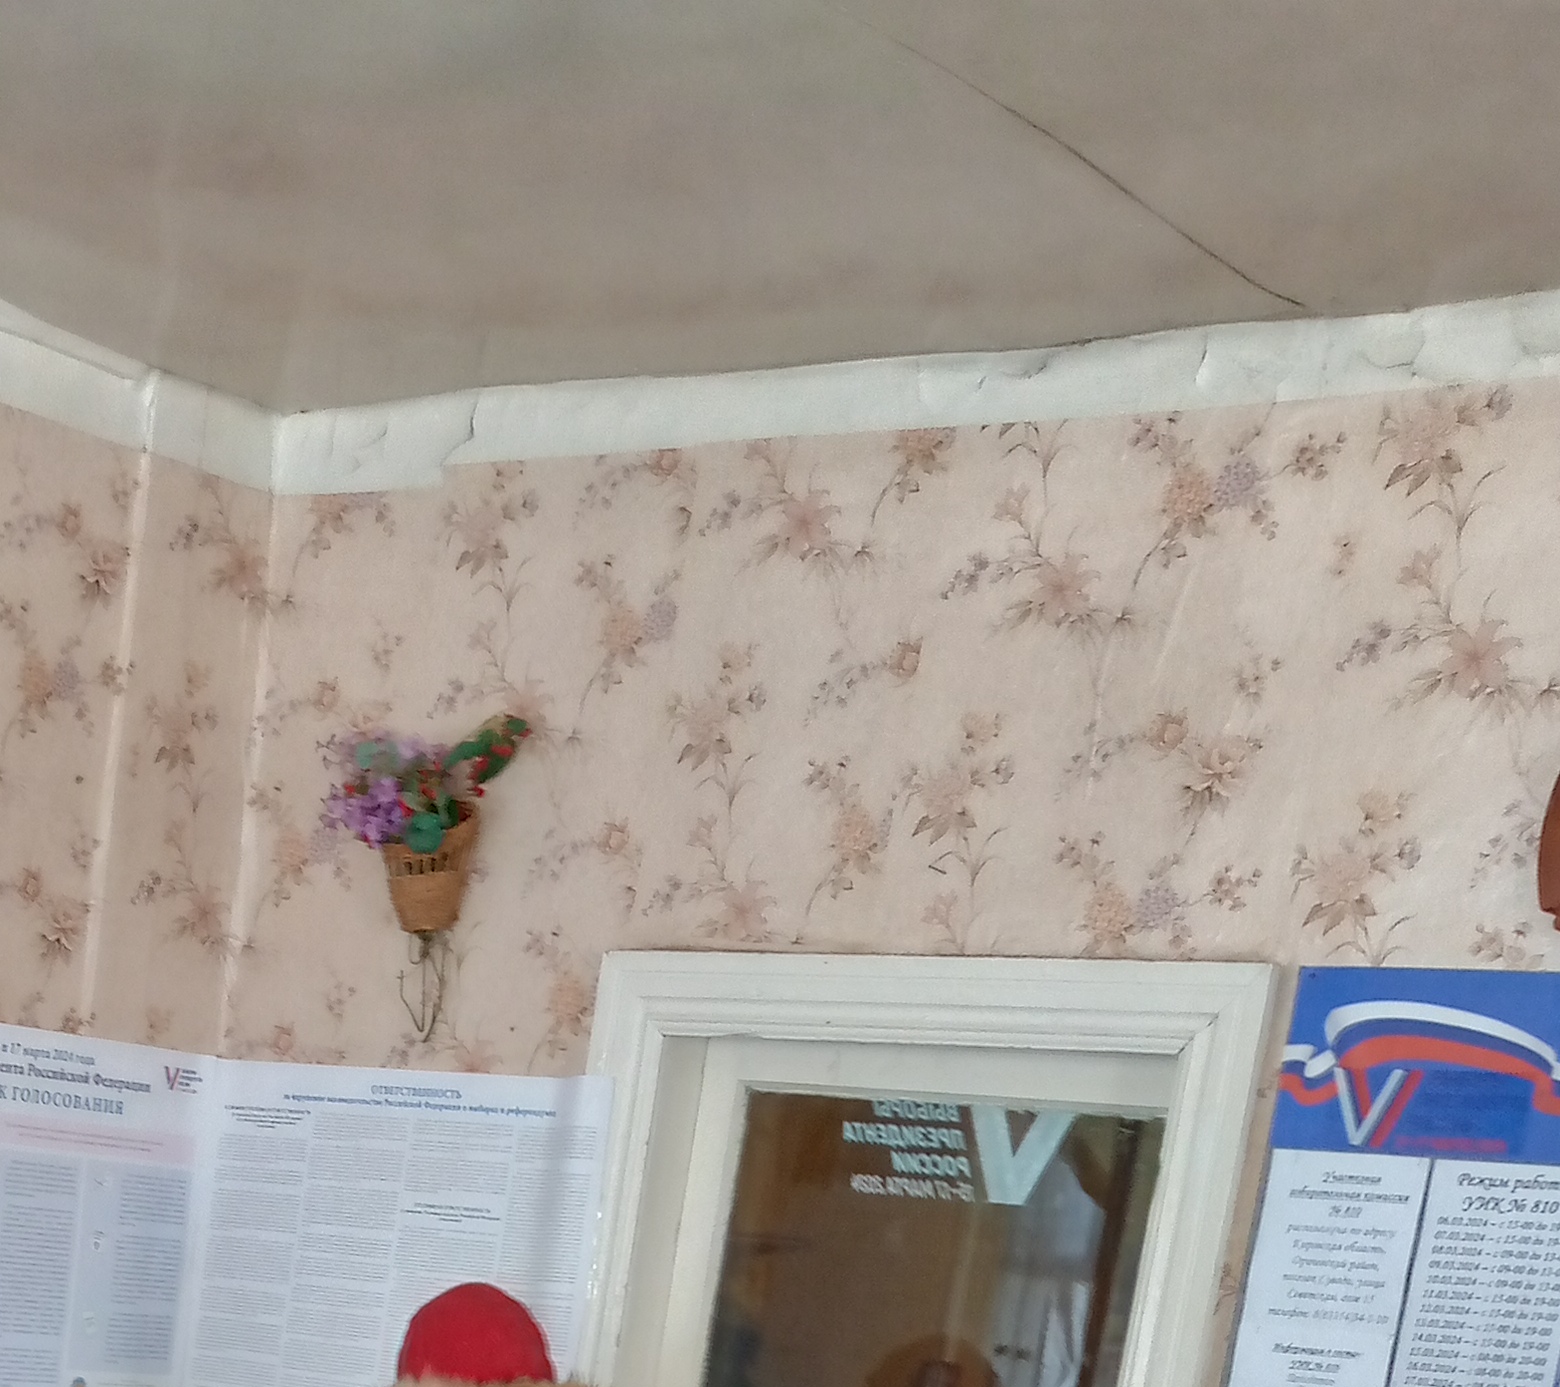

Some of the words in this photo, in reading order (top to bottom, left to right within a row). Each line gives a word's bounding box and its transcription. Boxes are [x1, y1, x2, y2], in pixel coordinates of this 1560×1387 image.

[27, 1062, 90, 1084] Российской
[92, 1072, 151, 1094] Федерации
[12, 1085, 124, 1115] ГОЛОСОВАНИЯ
[1458, 1172, 1509, 1191] Режим
[1511, 1174, 1560, 1193] работ
